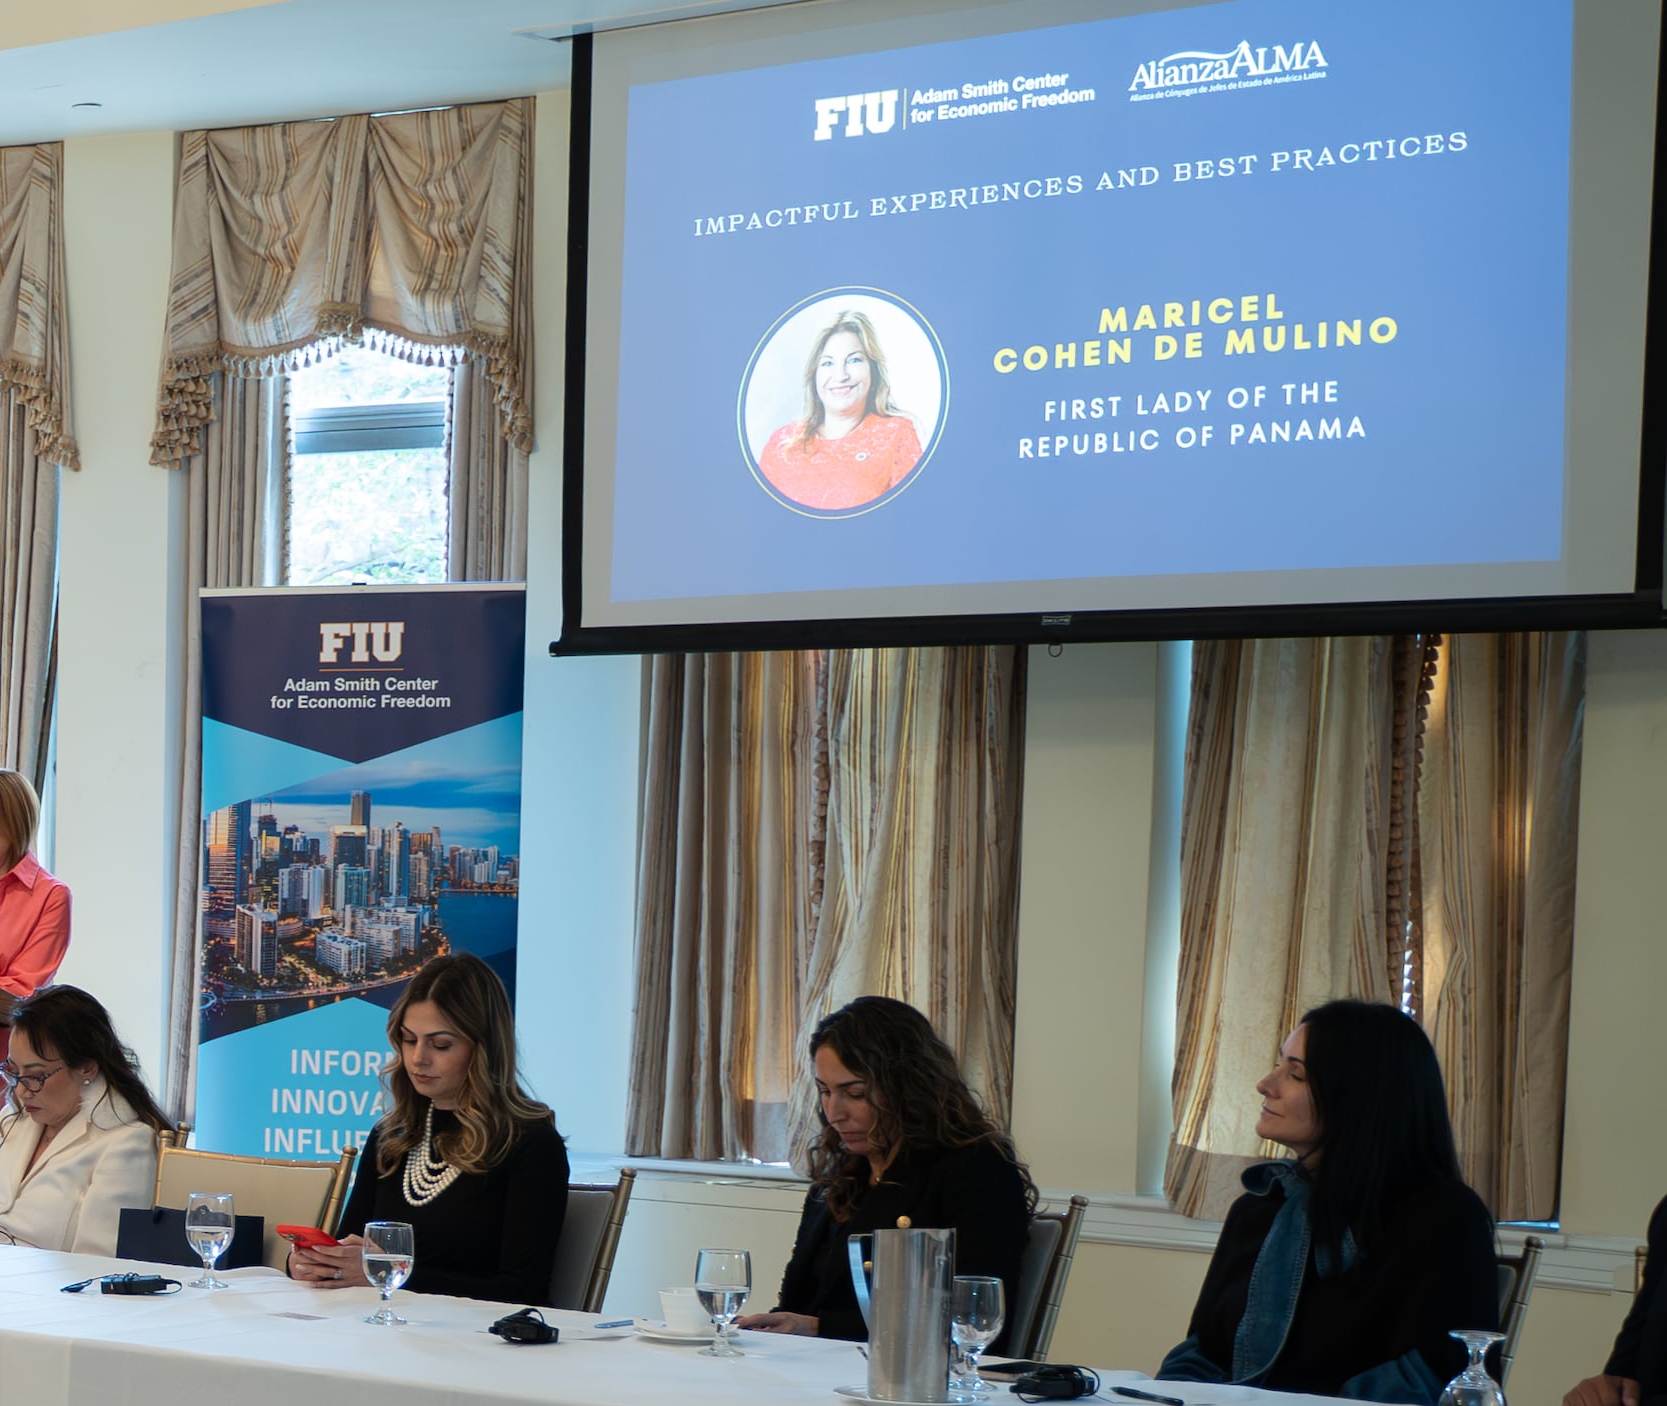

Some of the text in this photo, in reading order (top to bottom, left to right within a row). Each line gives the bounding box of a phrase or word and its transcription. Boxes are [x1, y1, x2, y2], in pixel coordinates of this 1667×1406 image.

[911, 73, 1069, 106] Adam Smith Center
[1130, 93, 1154, 102] Alianza
[1154, 90, 1164, 99] de
[1198, 85, 1208, 94] de
[1208, 83, 1227, 93] Jefes
[1228, 82, 1237, 90] de
[1238, 78, 1263, 88] Estado
[1263, 77, 1273, 86] de
[1273, 73, 1303, 84] América
[1303, 70, 1327, 80] Latina
[813, 89, 899, 141] FIU
[910, 88, 1095, 124] for Economic Freedom
[693, 131, 1468, 237] IMPACTFUL EXPERIENCES AND BEST PRACTICES
[1097, 293, 1284, 334] MARICEL
[993, 316, 1398, 374] COHEN DE MULINO
[1044, 381, 1339, 422] FIRST LADY OF THE
[1018, 416, 1366, 459] REPUBLIC OF PANAMA
[319, 622, 405, 663] FIU
[270, 694, 451, 709] for Economic Freedom
[283, 676, 439, 692] Adam Smith Center
[272, 1088, 387, 1116] INNOVA
[264, 1127, 370, 1155] INFLUE
